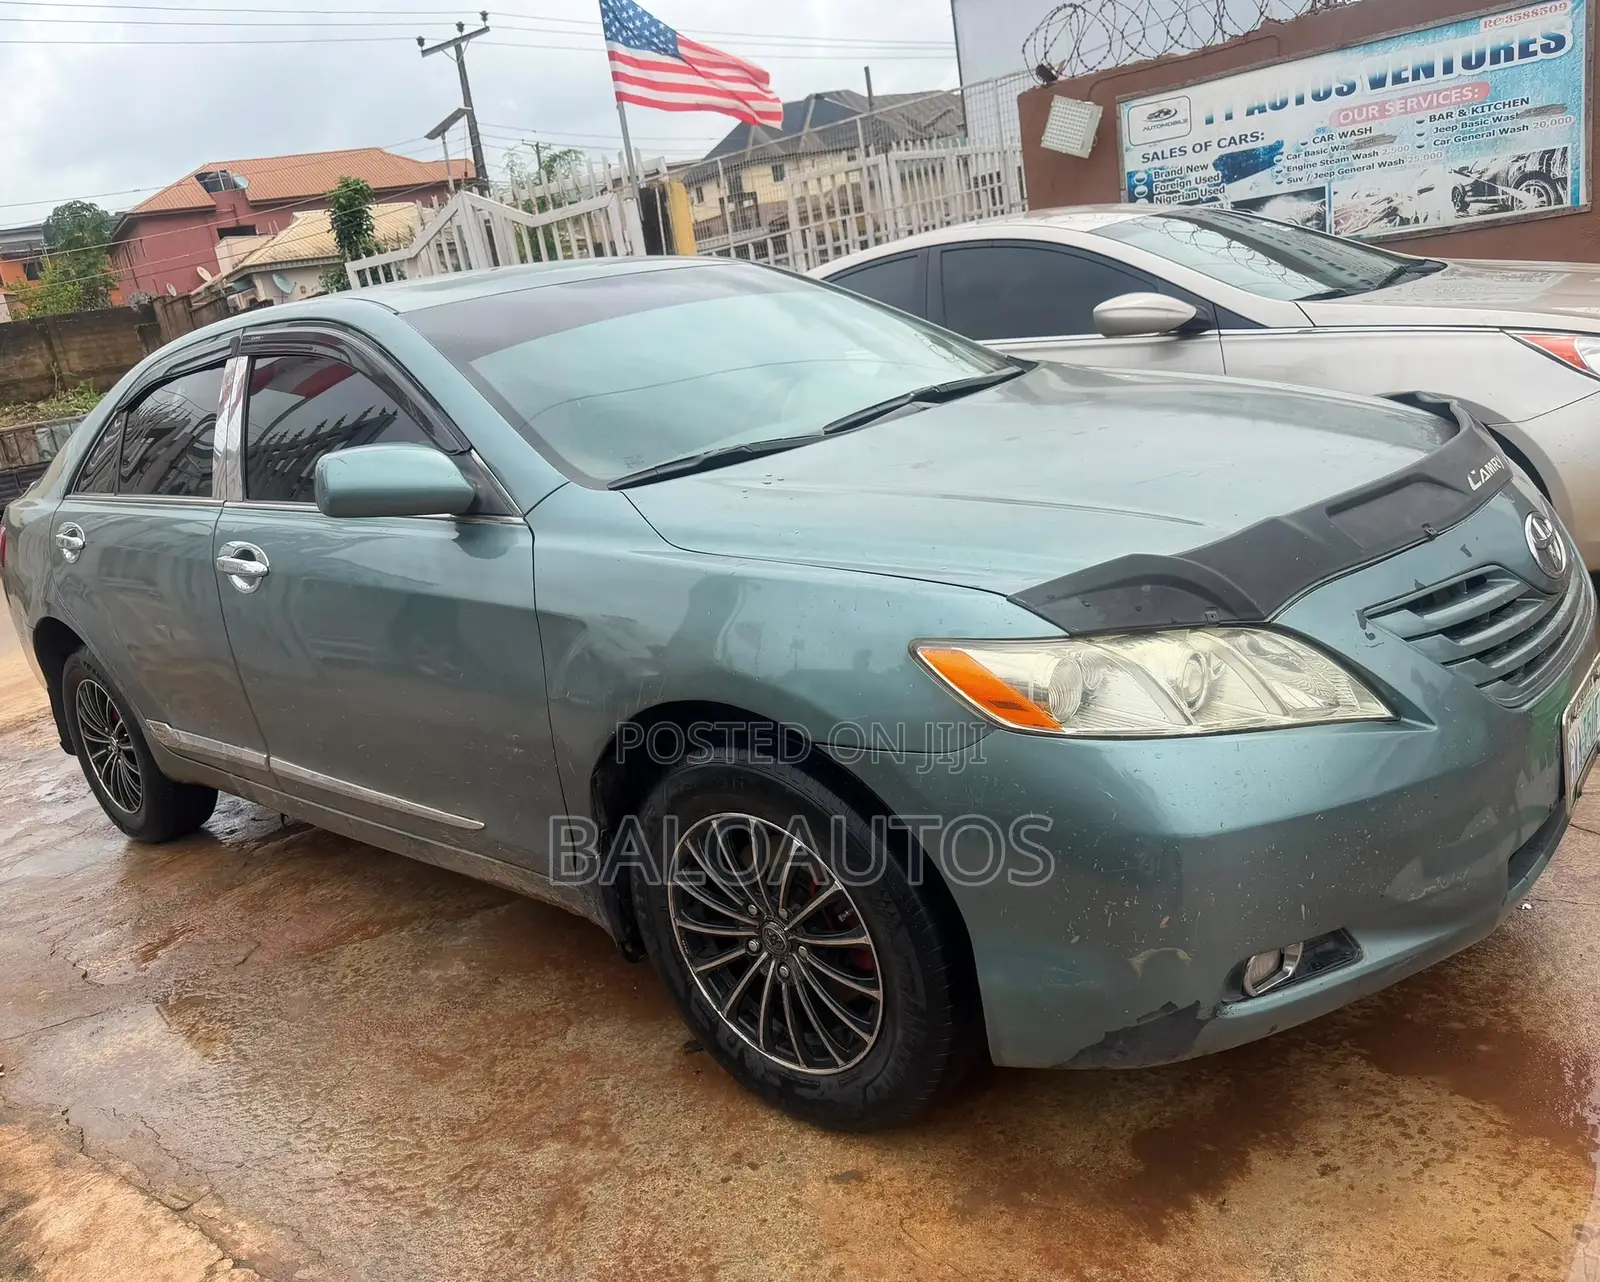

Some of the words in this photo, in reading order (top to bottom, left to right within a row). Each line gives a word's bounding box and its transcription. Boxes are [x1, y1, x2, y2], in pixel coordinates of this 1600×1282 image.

[1339, 107, 1379, 124] OUR
[1385, 87, 1479, 115] SERVICES:
[1429, 112, 1454, 123] BAR
[1458, 109, 1467, 118] &
[1471, 97, 1530, 115] KITCHEN
[1312, 134, 1336, 145] CAR
[1338, 126, 1373, 139] WASH
[1433, 125, 1457, 135] Jeep
[1461, 119, 1489, 129] Basic
[1434, 139, 1451, 147] Car
[1454, 130, 1495, 143] General
[1498, 124, 1529, 136] Wash
[1532, 117, 1572, 130] 20,000
[1141, 146, 1187, 164] SALES
[1192, 140, 1212, 154] OF
[1217, 131, 1265, 149] CARS:
[1286, 152, 1302, 161] Car
[1304, 147, 1328, 157] Basic
[1153, 167, 1183, 179] Brand
[1186, 162, 1209, 173] New
[1287, 161, 1317, 173] Engine
[1320, 156, 1349, 166] Steam
[1352, 150, 1379, 160] Wash
[1287, 176, 1303, 184] Suv
[1313, 170, 1335, 180] Jeep
[1337, 163, 1375, 176] General
[1377, 158, 1405, 169] Wash
[1154, 179, 1192, 193] Foreign
[1194, 173, 1220, 185] Used
[1155, 190, 1198, 204] Nigerian
[1200, 185, 1226, 197] Used
